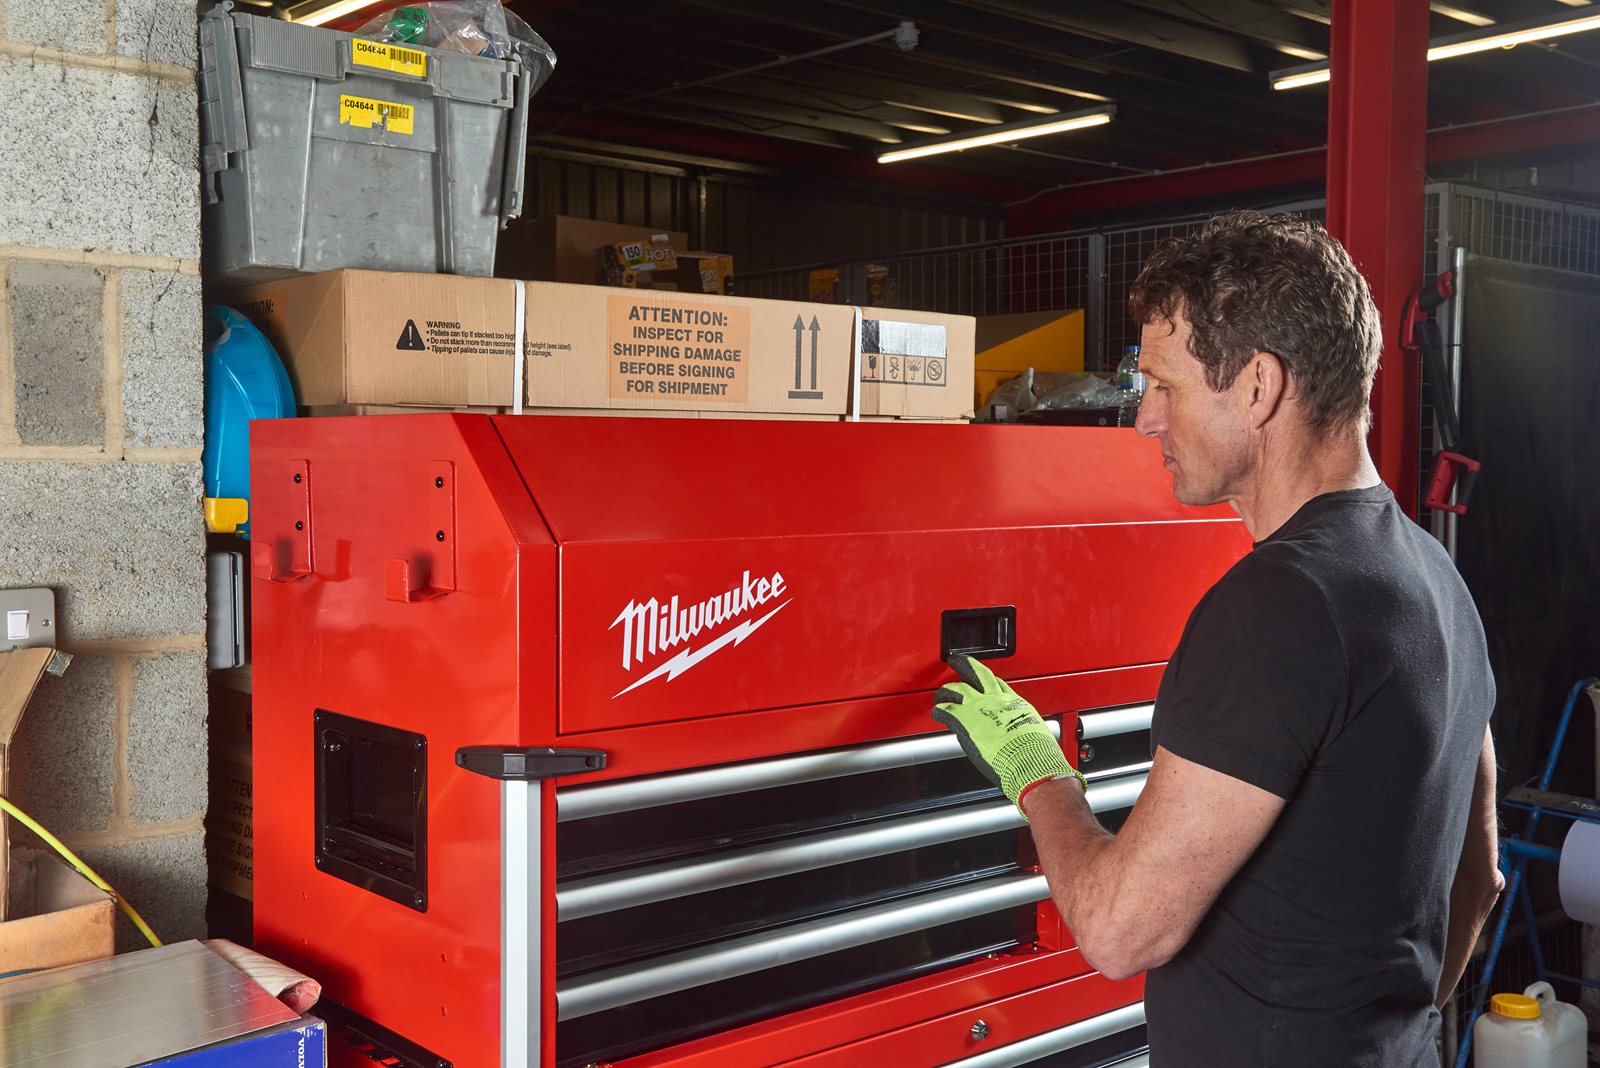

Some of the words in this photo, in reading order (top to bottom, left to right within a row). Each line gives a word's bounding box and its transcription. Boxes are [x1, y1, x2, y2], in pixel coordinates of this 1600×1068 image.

[344, 99, 374, 111] C04644
[625, 245, 641, 258] 150
[628, 305, 728, 327] ATTENTION:
[426, 321, 461, 329] WARNING
[430, 329, 449, 337] Pallets
[461, 331, 469, 339] tip
[474, 331, 494, 339] stacked
[633, 326, 692, 341] INSPECT
[697, 330, 724, 344] FOR
[431, 345, 453, 354] Tipping
[460, 346, 478, 354] pallets
[532, 349, 552, 358] damage.
[530, 341, 546, 350] height
[558, 343, 572, 351] label)
[613, 343, 680, 359] SHIPPING
[684, 347, 742, 362] DAMAGE
[619, 361, 675, 376] BEFORE
[678, 364, 735, 379] SIGNING
[626, 380, 655, 393] FOR
[658, 381, 728, 395] SHIPMENT
[608, 570, 787, 671] Milwaukee
